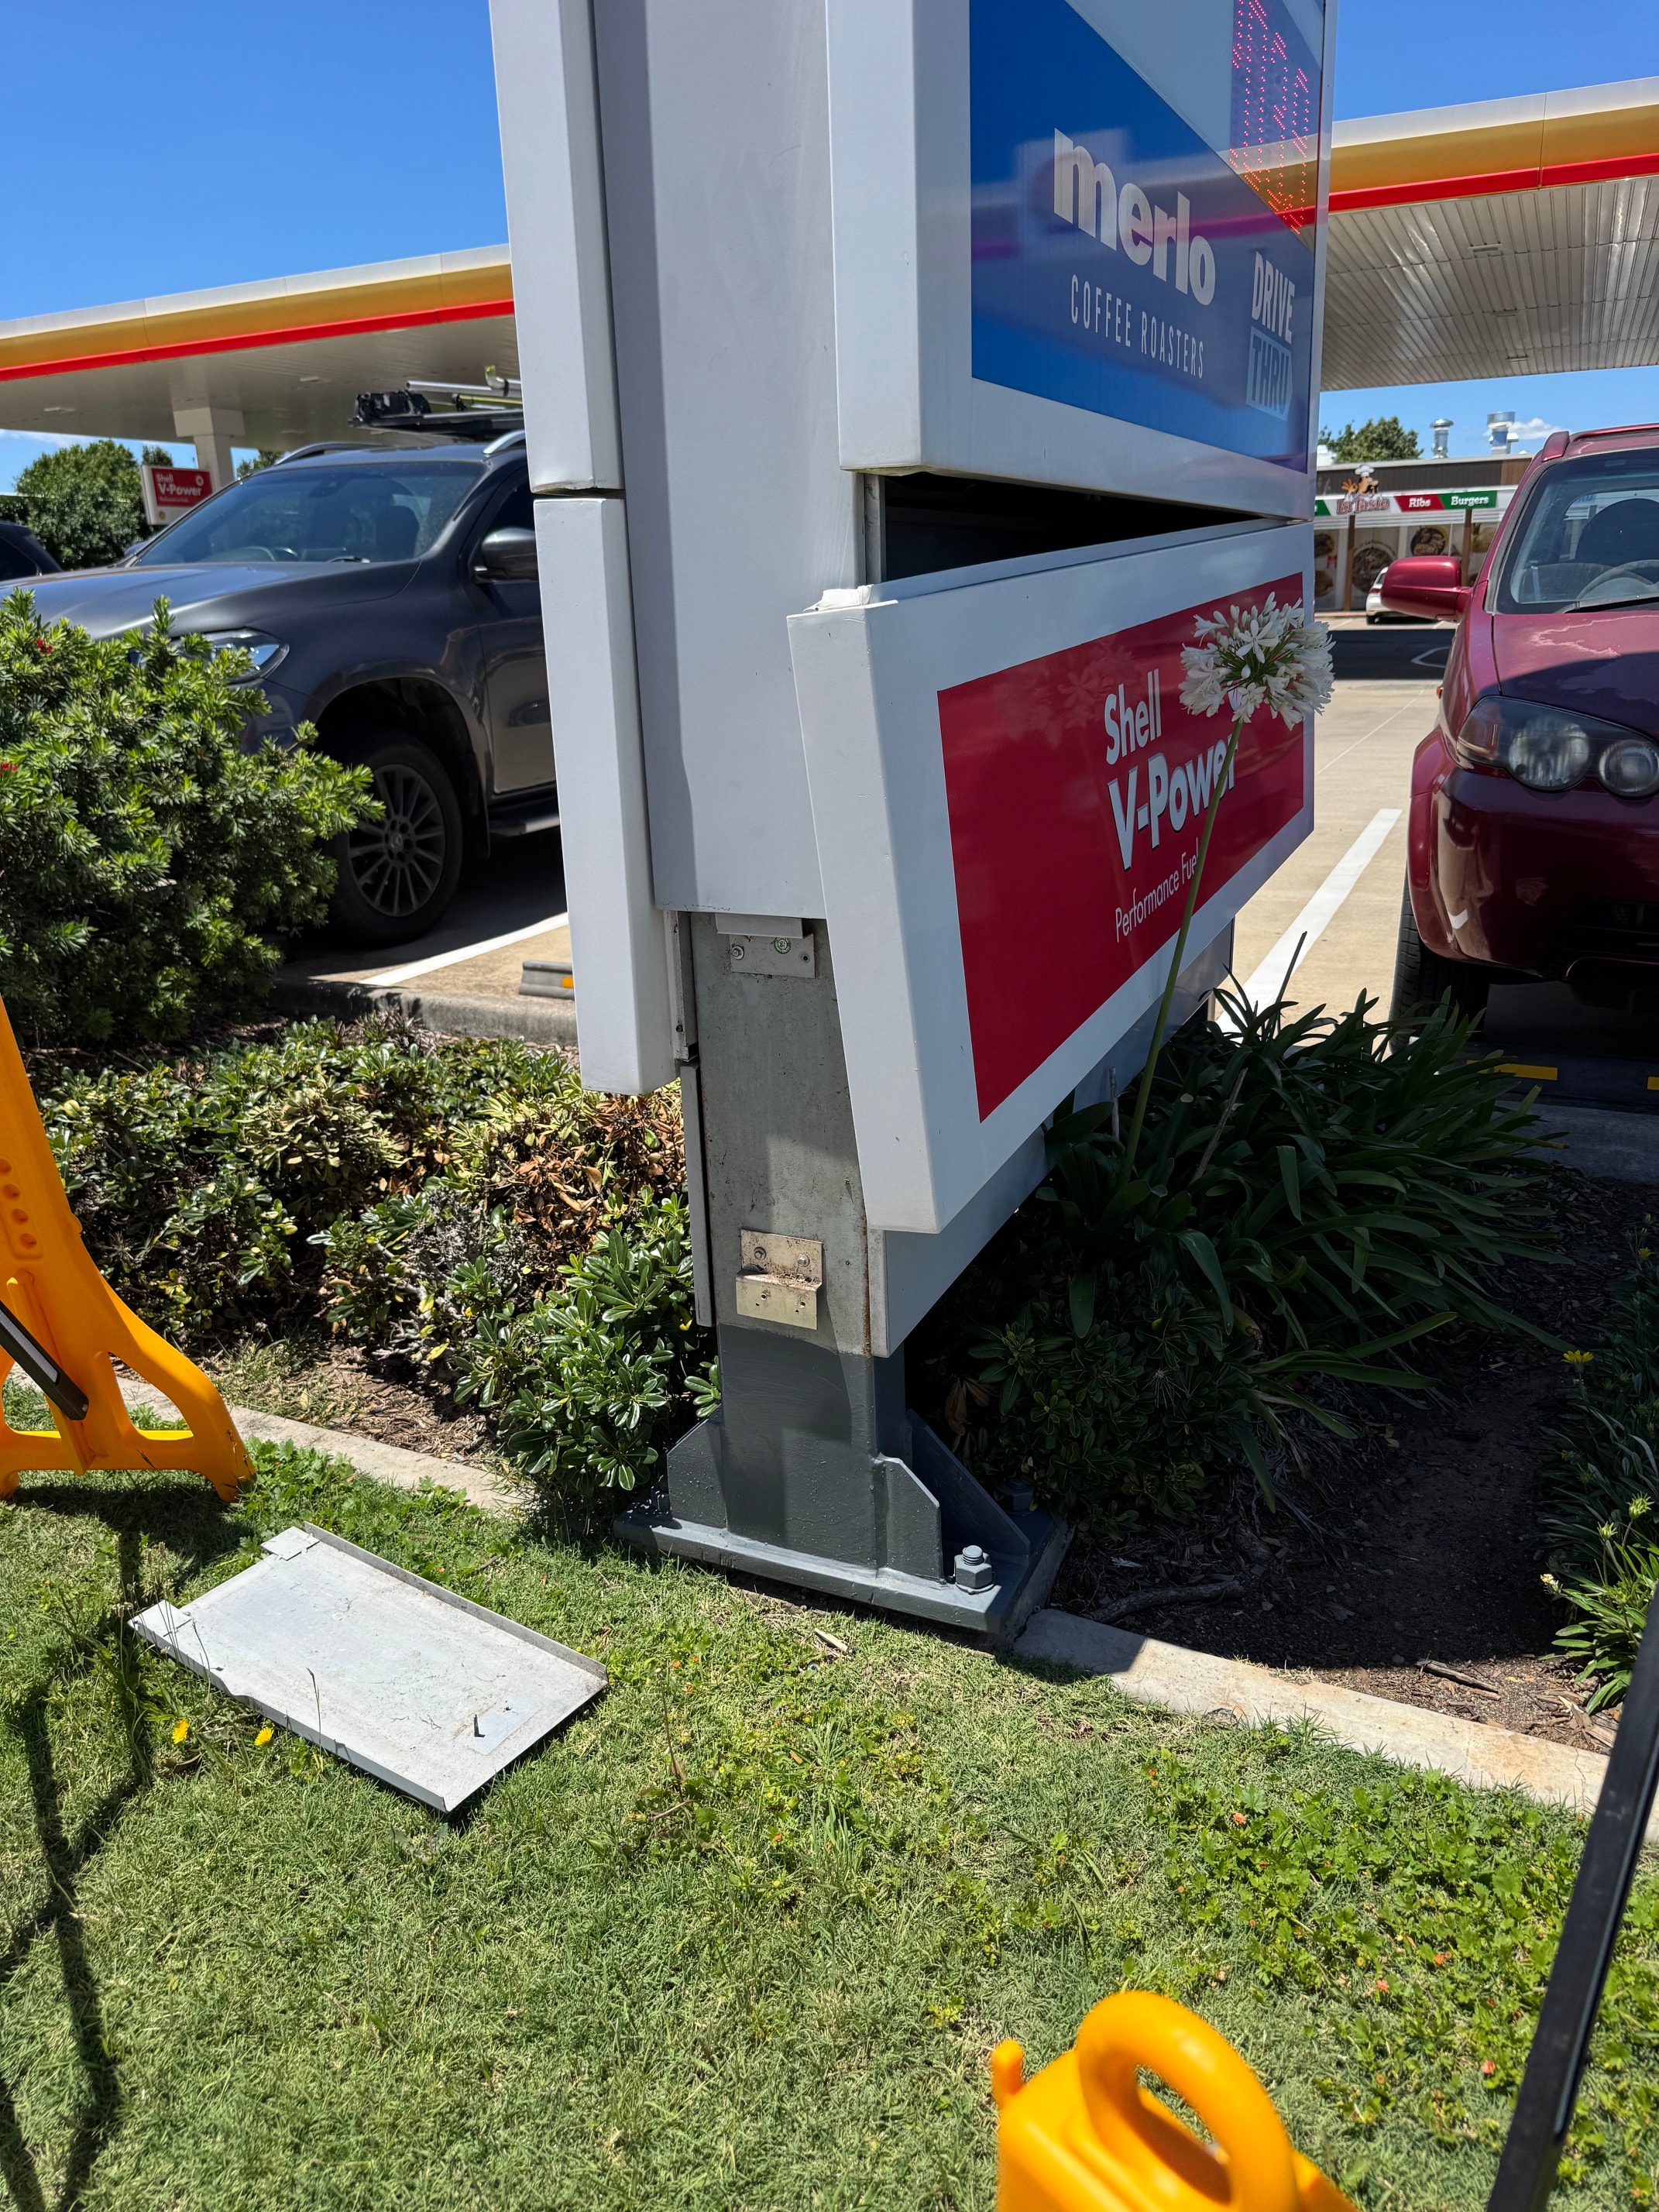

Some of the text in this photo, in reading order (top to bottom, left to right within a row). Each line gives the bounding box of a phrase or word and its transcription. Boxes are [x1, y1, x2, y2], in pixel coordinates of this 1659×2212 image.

[1053, 128, 1216, 306] merlo
[1071, 274, 1204, 380] COFFEE ROASTERS
[1252, 251, 1295, 345] DRIVE
[1252, 335, 1289, 416] THRU
[156, 473, 174, 484] Shell
[157, 483, 201, 496] V-Power
[1409, 496, 1431, 508] Ribs
[1451, 496, 1489, 507] Burgers
[1104, 669, 1162, 765] Shell
[1108, 733, 1238, 871] V-Power
[1115, 875, 1180, 943] Performance
